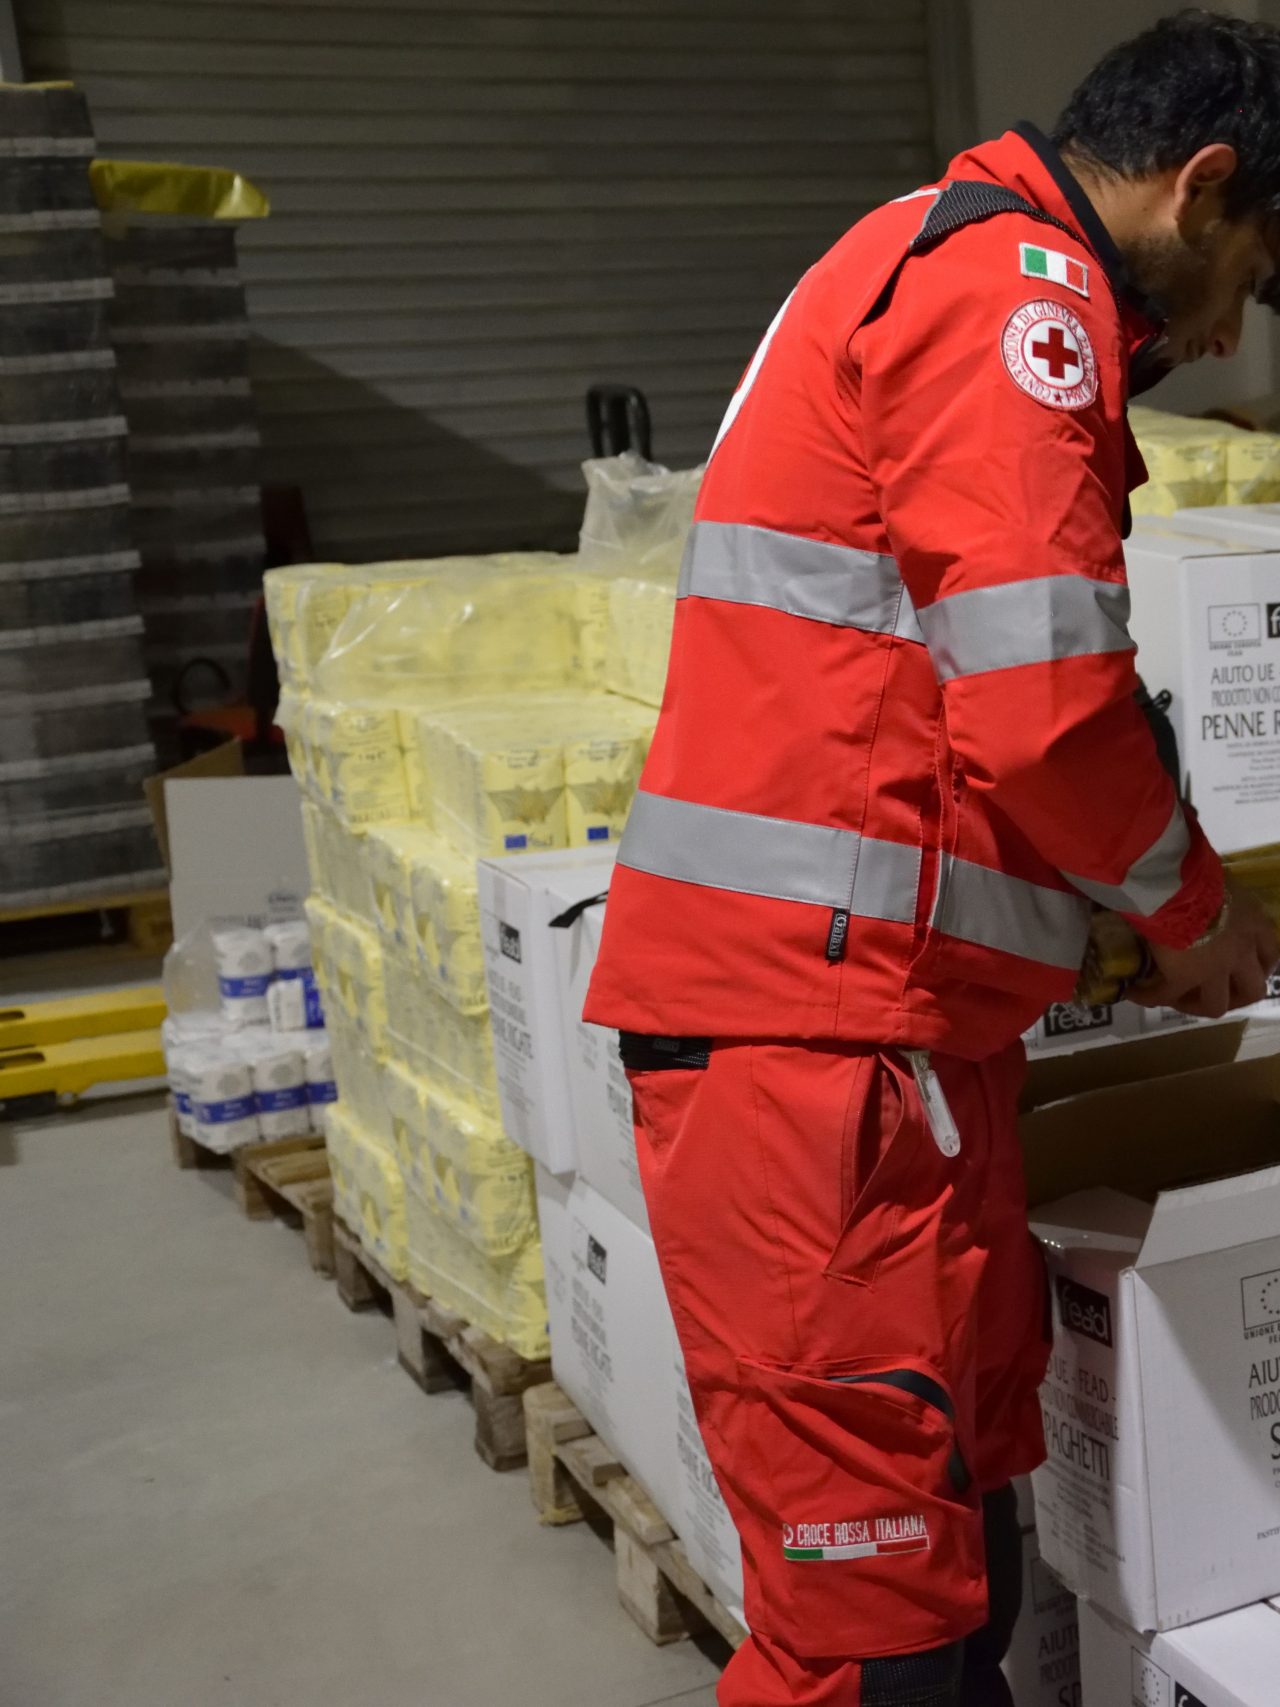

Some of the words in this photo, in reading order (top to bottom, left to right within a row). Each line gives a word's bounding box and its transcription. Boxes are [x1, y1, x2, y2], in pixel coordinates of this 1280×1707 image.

[1017, 309, 1034, 325] DI
[1211, 664, 1254, 685] AIUTO
[1257, 662, 1275, 683] UE
[1201, 710, 1266, 741] PENNE
[1244, 1326, 1276, 1341] UNIONE
[1079, 1367, 1109, 1403] FEAD
[1044, 1409, 1110, 1481] PAGHETTI
[797, 1523, 831, 1546] CROCE
[834, 1520, 870, 1545] ROSSA
[875, 1514, 927, 1540] ITALIANA
